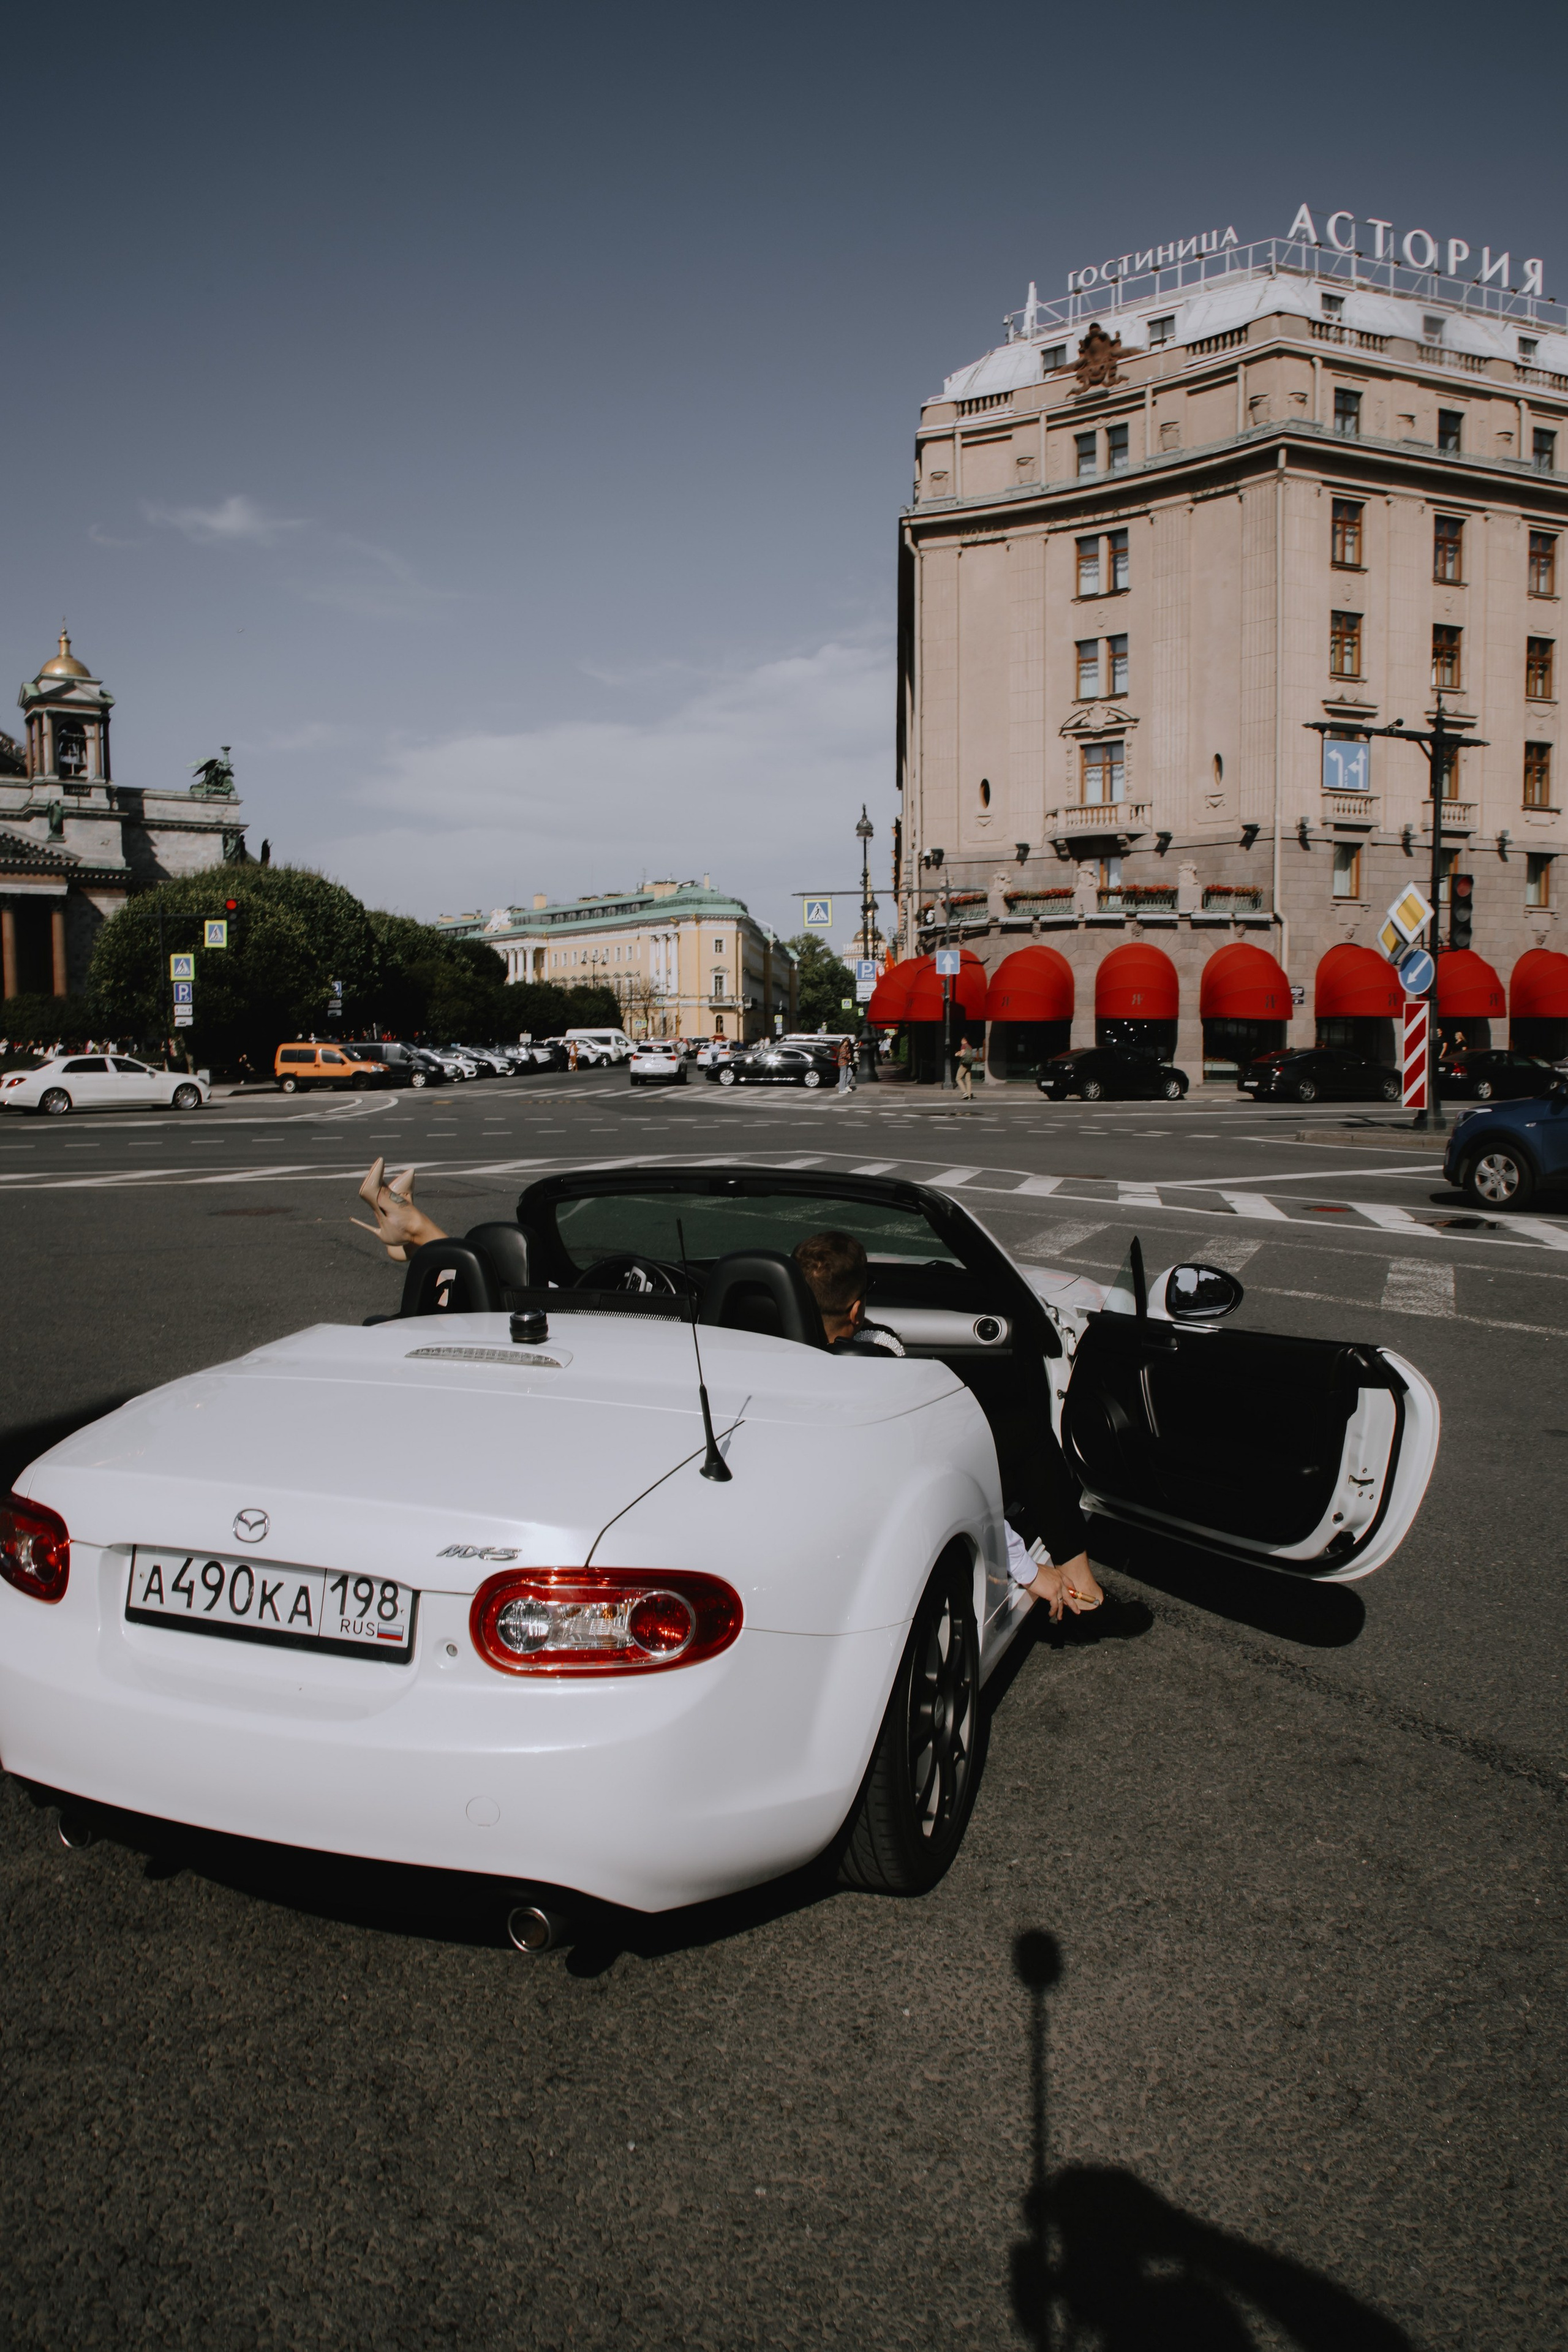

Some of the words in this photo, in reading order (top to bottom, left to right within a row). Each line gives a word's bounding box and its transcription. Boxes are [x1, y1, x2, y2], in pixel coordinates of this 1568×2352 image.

[1068, 225, 1238, 292] ГОСТИНИЦА
[1287, 203, 1543, 296] АСТОРИЯ
[861, 962, 873, 978] P
[178, 984, 189, 1001] P
[330, 1574, 399, 1621] 198
[341, 1619, 375, 1636] RUS
